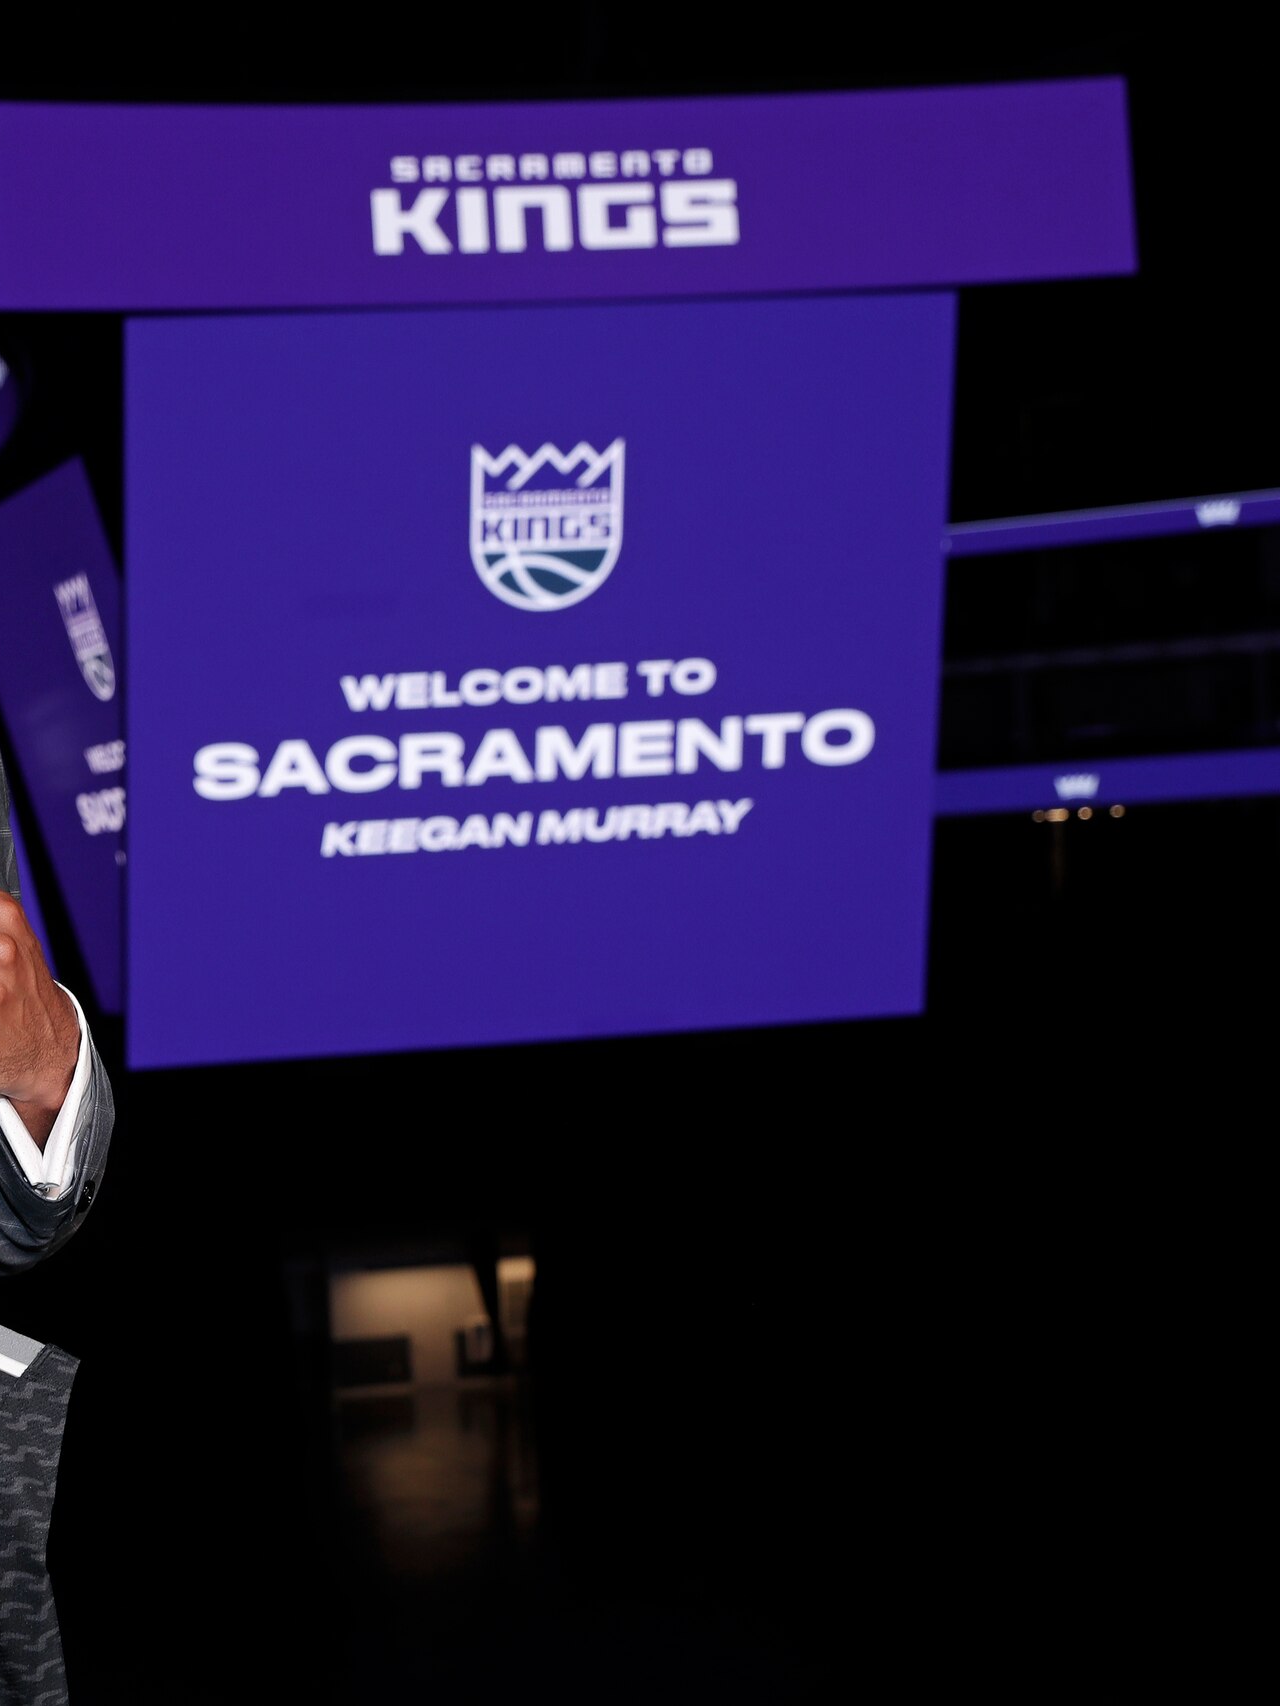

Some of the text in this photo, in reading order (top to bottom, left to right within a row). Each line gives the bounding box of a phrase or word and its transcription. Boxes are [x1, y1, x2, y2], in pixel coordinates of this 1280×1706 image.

[390, 148, 714, 183] SACRAMENTO
[370, 178, 741, 256] KINGS
[481, 513, 611, 544] KINGS
[339, 657, 717, 712] WELCOME TO
[192, 708, 876, 801] SACRAMENTO
[320, 797, 754, 858] KEEGAN MURRAY
